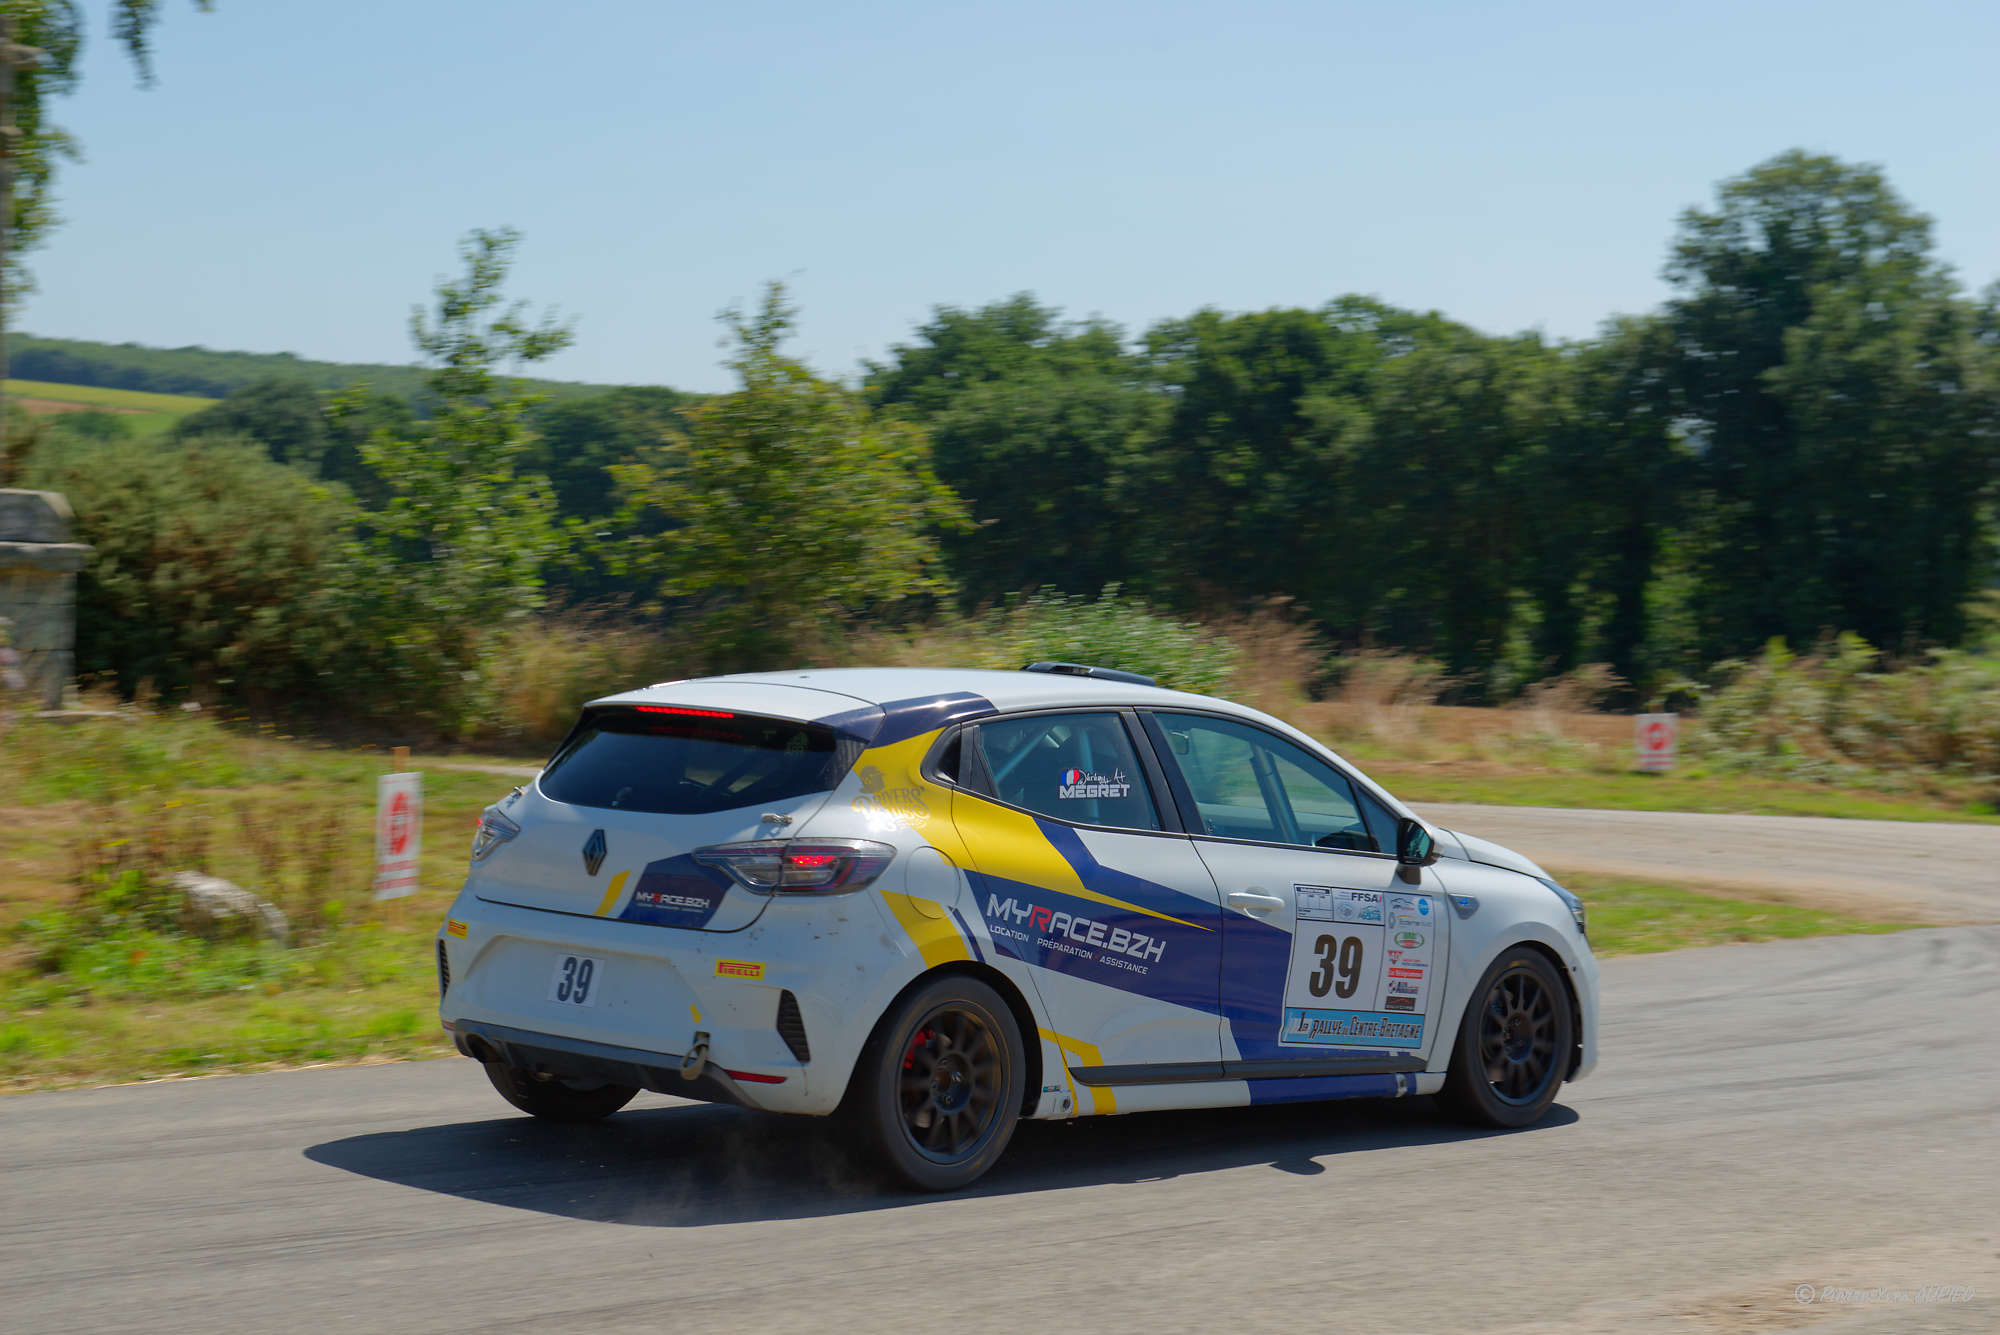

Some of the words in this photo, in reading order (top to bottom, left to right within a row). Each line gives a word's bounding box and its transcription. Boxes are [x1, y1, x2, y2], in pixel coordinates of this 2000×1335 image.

[1351, 892, 1378, 903] FFSA
[986, 892, 1167, 963] MYRACE.BZH
[989, 924, 1030, 942] LOCATION
[1099, 955, 1148, 975] ASSISTANCE
[556, 956, 594, 1004] 39
[719, 962, 761, 977] PIRELLI
[1309, 934, 1364, 999] 39
